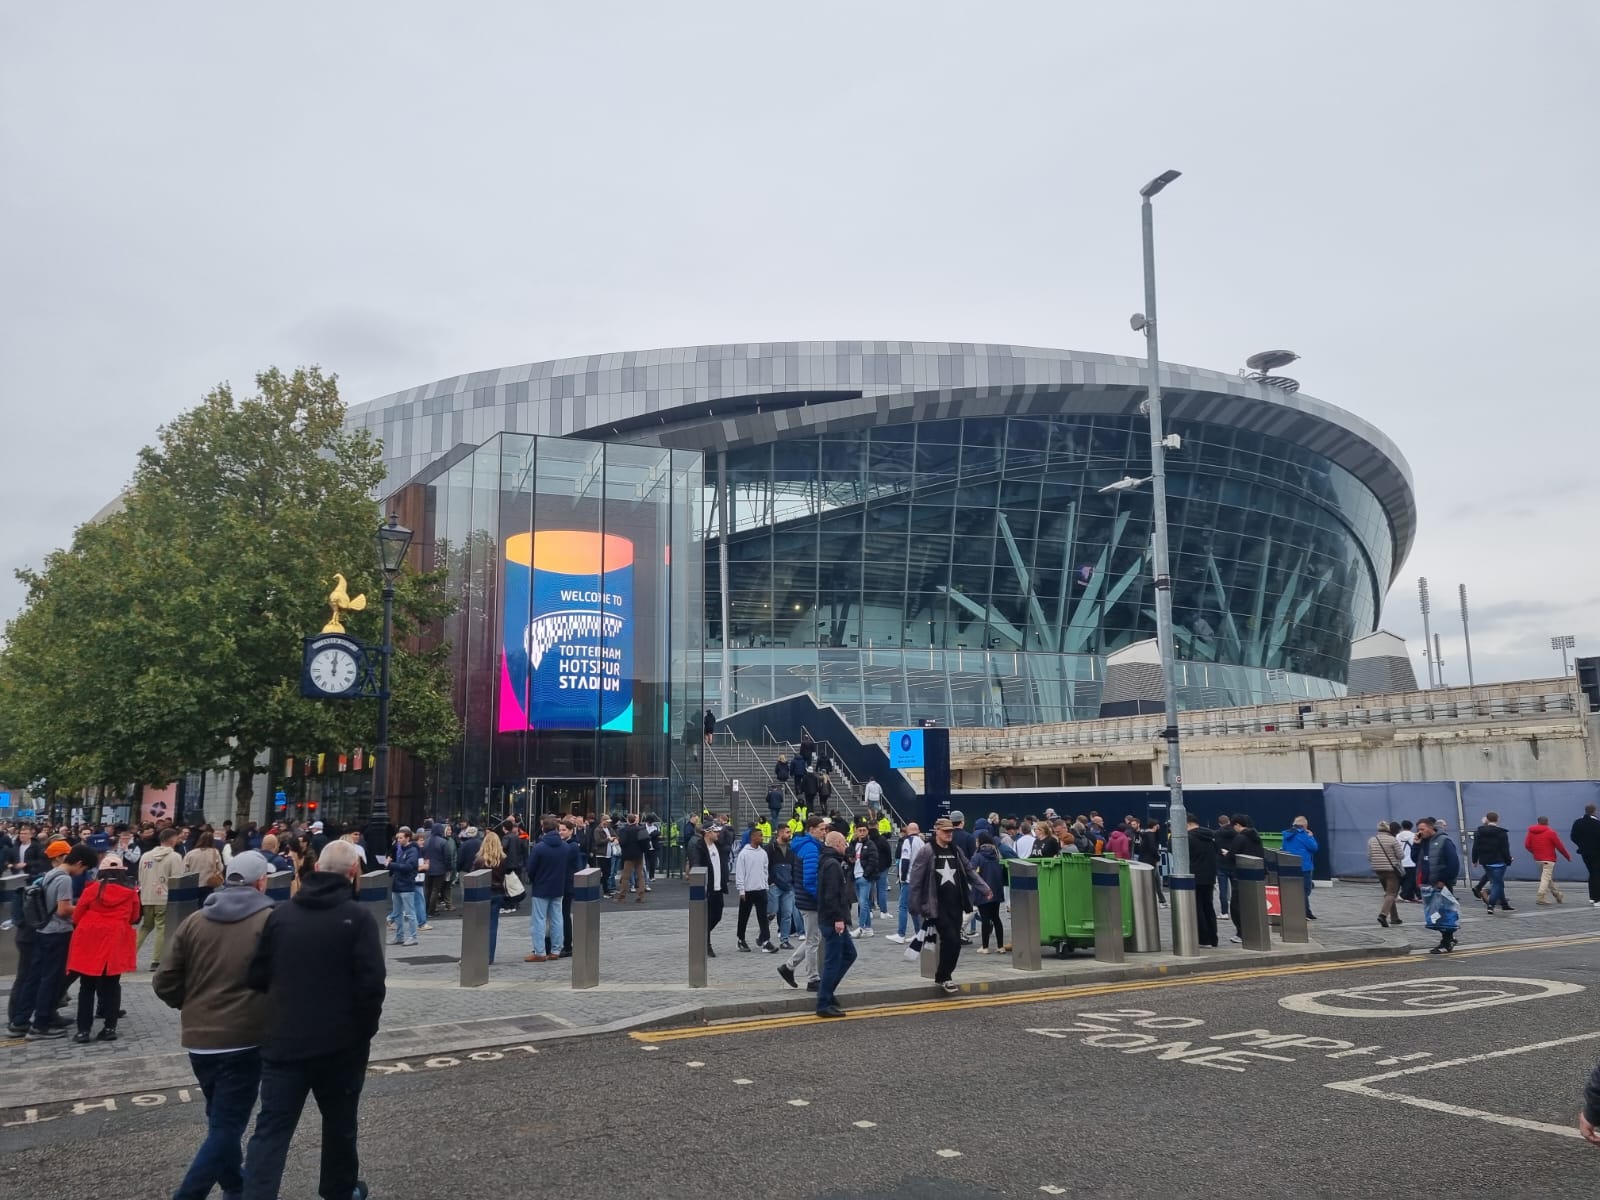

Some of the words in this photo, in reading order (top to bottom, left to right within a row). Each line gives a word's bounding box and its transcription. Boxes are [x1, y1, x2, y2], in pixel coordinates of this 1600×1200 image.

[612, 594, 622, 606] TO
[559, 645, 621, 659] TOTTENHAM
[559, 659, 620, 675] HOTSPUR
[559, 675, 620, 692] STADIUM
[1077, 1009, 1206, 1029] 20
[1025, 1022, 1296, 1073] ZONE
[367, 1045, 540, 1075] LOOK
[2, 1088, 202, 1128] IGHT
